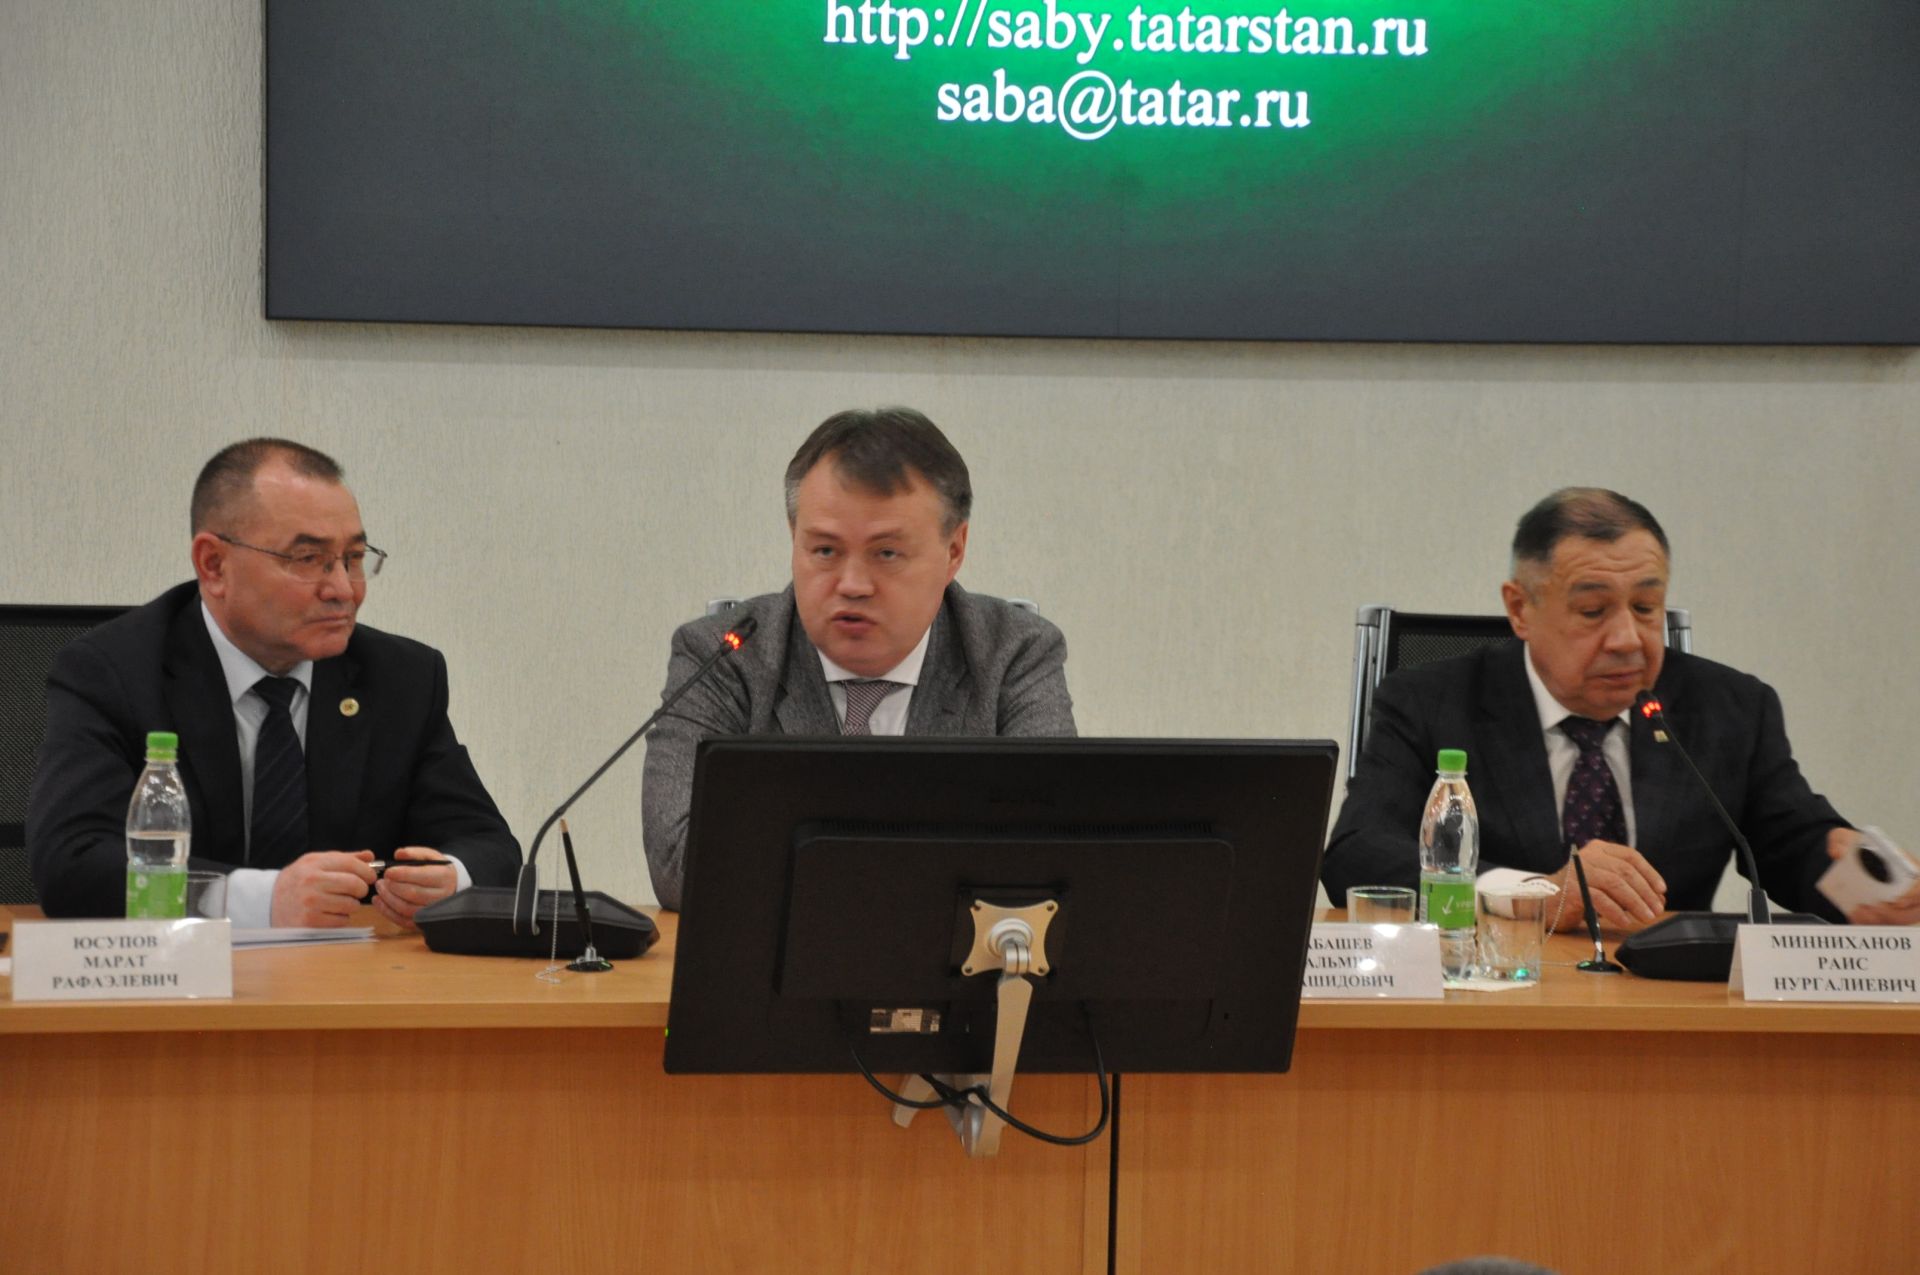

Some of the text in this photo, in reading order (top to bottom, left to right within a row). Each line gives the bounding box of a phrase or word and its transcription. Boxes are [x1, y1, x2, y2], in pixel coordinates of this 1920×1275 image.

[824, 0, 1429, 63] http://saby.tatarstan.ru
[937, 69, 1310, 140] saba@tatar.ru
[73, 935, 158, 950] ЮСУПОВ
[1771, 935, 1912, 951] МИННИХАНОВ
[83, 955, 147, 969] МАРАТ
[1818, 956, 1869, 971] РАИС
[52, 974, 179, 989] РАФАЭЛЕВИЧ
[1774, 976, 1917, 992] НУРГАЛИЕВИЧ
